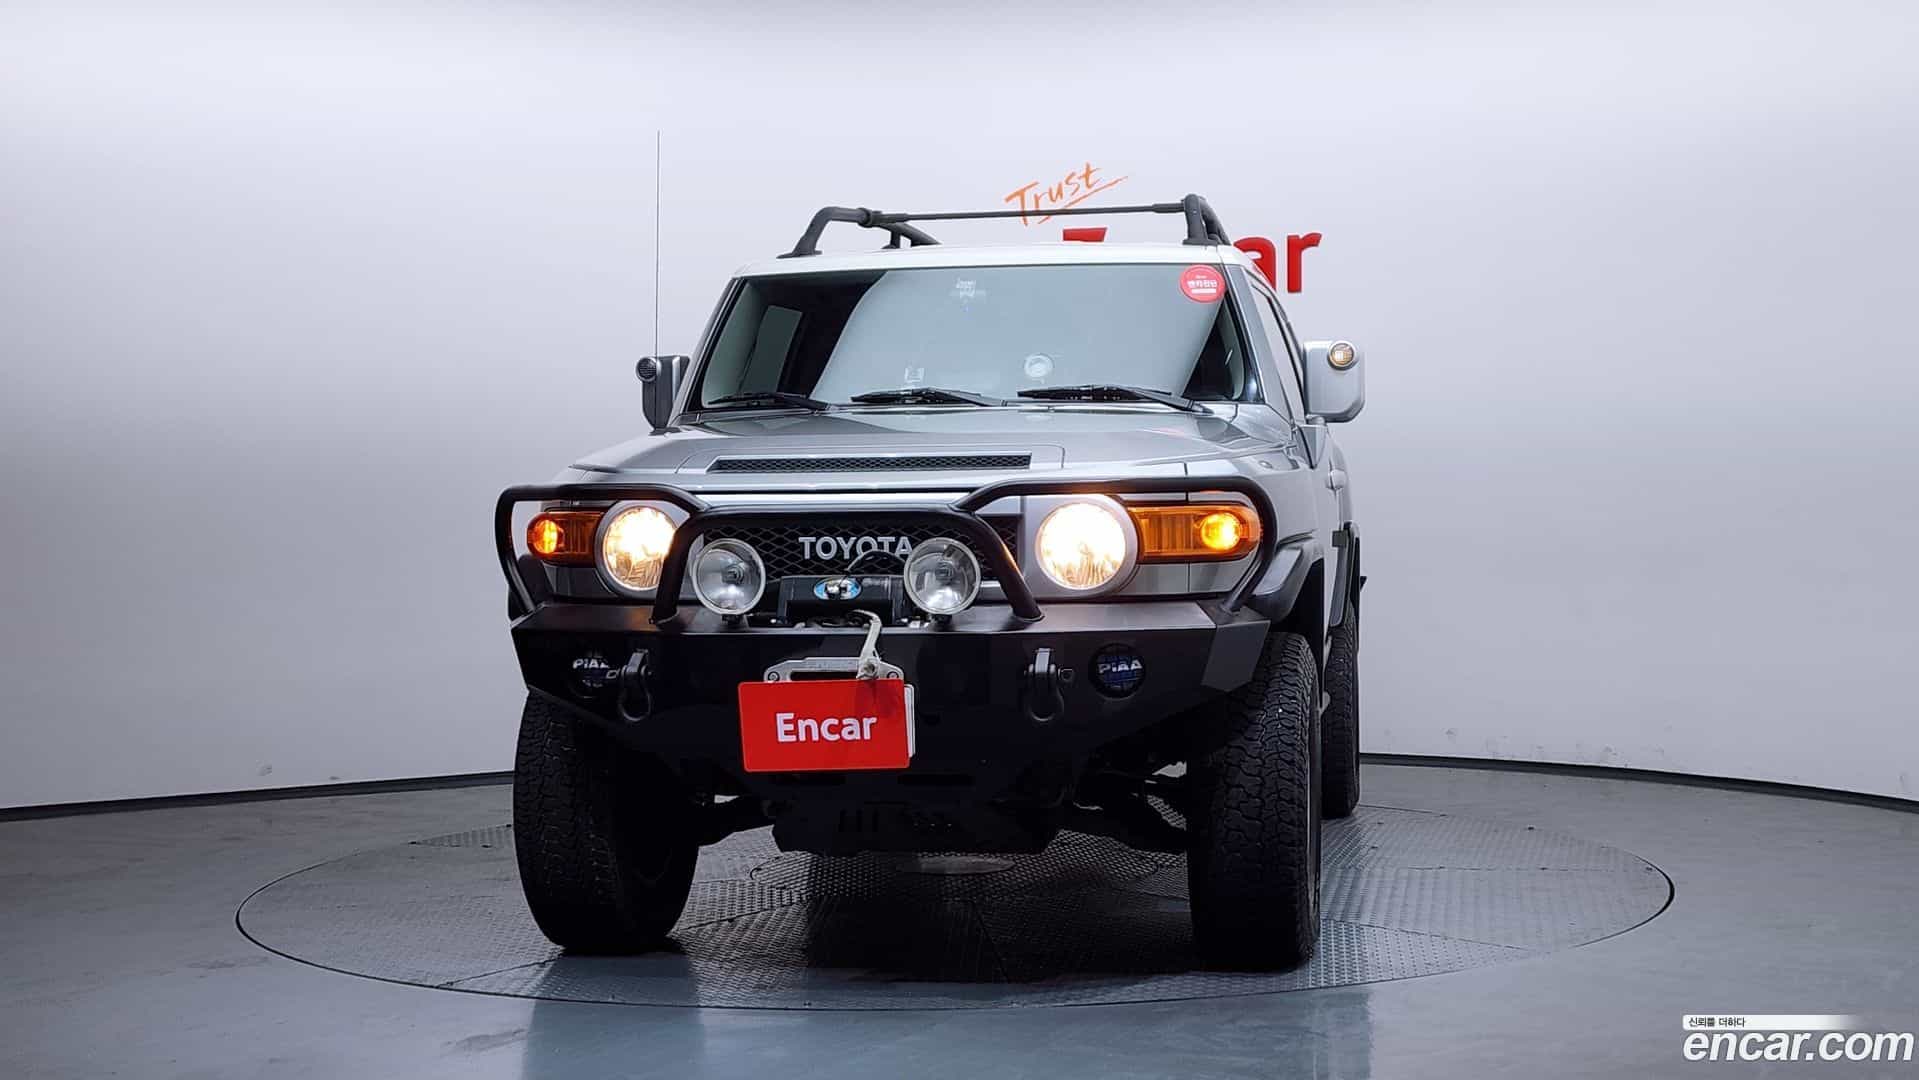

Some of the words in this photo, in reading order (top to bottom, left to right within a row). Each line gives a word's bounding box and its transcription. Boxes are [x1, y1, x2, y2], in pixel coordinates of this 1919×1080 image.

[1004, 162, 1104, 227] Trust
[798, 536, 913, 560] TOYOTA
[776, 712, 877, 742] Encar
